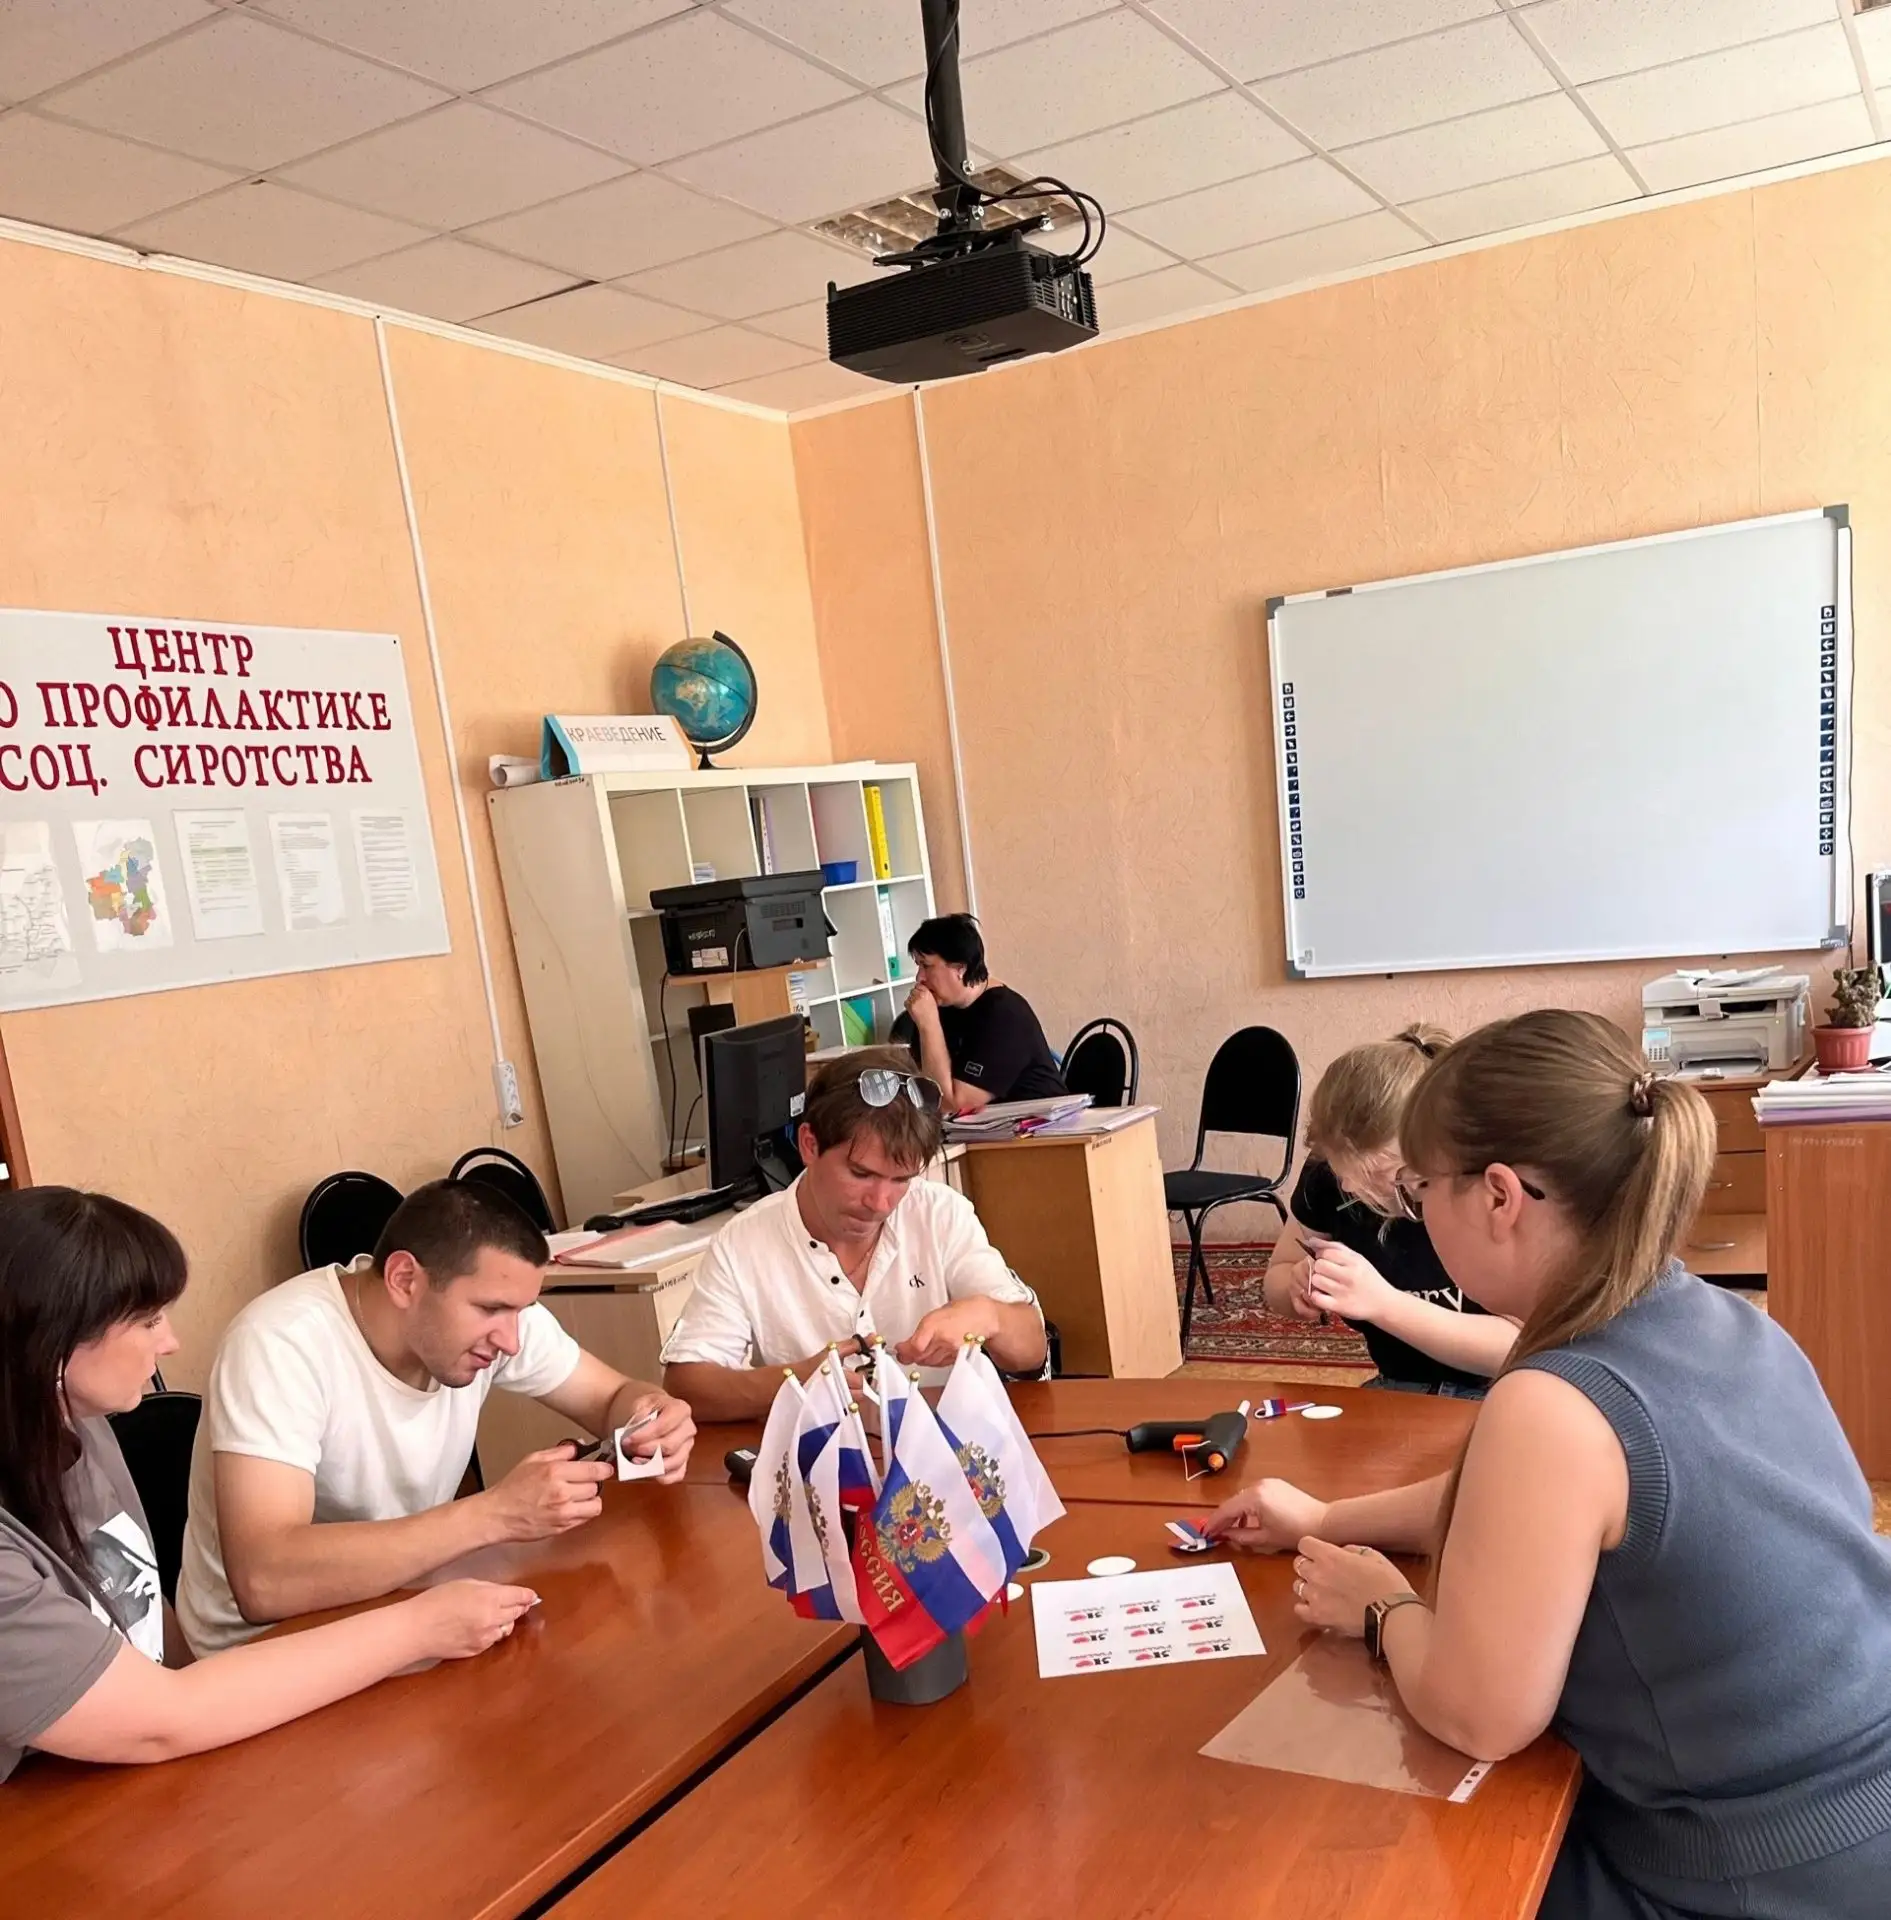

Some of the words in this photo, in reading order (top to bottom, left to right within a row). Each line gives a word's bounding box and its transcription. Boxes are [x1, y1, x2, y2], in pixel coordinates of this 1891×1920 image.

[107, 626, 253, 679] ЦЕНТР
[36, 681, 391, 731] ПРОФИЛАКТИКЕ
[565, 726, 667, 744] КРАЕВЕДЕНИЕ
[0, 744, 108, 797] СОЦ.
[133, 744, 373, 788] СИРОТСТВА
